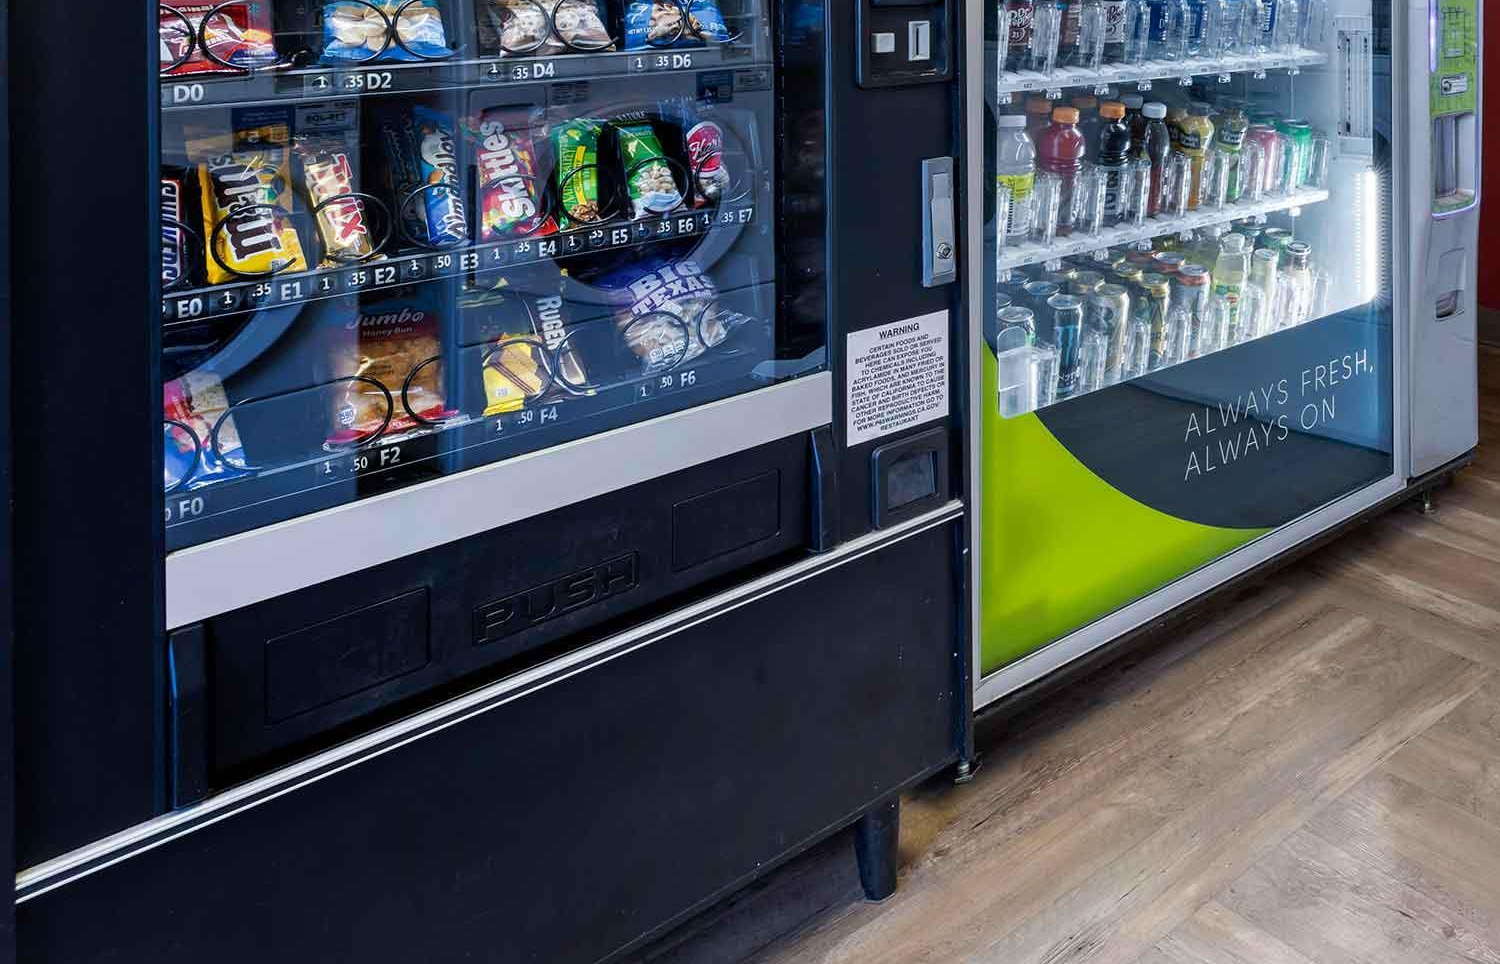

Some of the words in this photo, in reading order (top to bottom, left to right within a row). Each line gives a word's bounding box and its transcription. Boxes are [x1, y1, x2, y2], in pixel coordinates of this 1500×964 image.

[655, 55, 669, 68] .35
[672, 53, 692, 70] D6
[512, 67, 529, 80] .35
[533, 62, 555, 79] D4
[344, 74, 364, 89] .35
[367, 72, 392, 90] D2
[173, 83, 205, 103] D0
[737, 207, 753, 224] E7
[656, 221, 671, 235] .35
[677, 217, 694, 235] E6
[611, 228, 629, 245] E5
[514, 240, 530, 254] .35
[537, 239, 557, 257] E4
[433, 254, 452, 270] .50
[459, 252, 479, 270] E3
[348, 271, 367, 287] .35
[374, 267, 396, 286] E2
[627, 260, 701, 301] BIG
[251, 283, 272, 298] .35
[280, 283, 303, 300] E1
[177, 298, 203, 319] E0
[879, 322, 919, 340] WARNING
[869, 342, 895, 354] CERTAIN
[896, 336, 915, 347] FOODS
[917, 333, 928, 341] AND
[871, 360, 904, 374] CHEMICALS
[659, 373, 674, 388] .50
[680, 370, 697, 387] F6
[1184, 379, 1290, 442] ALWAYS
[1301, 349, 1374, 396] FRESH,
[517, 409, 534, 425] .50
[540, 408, 559, 425] F4
[851, 401, 877, 414] CANCER
[1184, 416, 1290, 481] ALWAYS
[1301, 396, 1336, 430] ON
[350, 457, 369, 473] .50
[379, 446, 401, 467] F2
[178, 496, 205, 519] F0
[478, 559, 629, 643] PUSH
